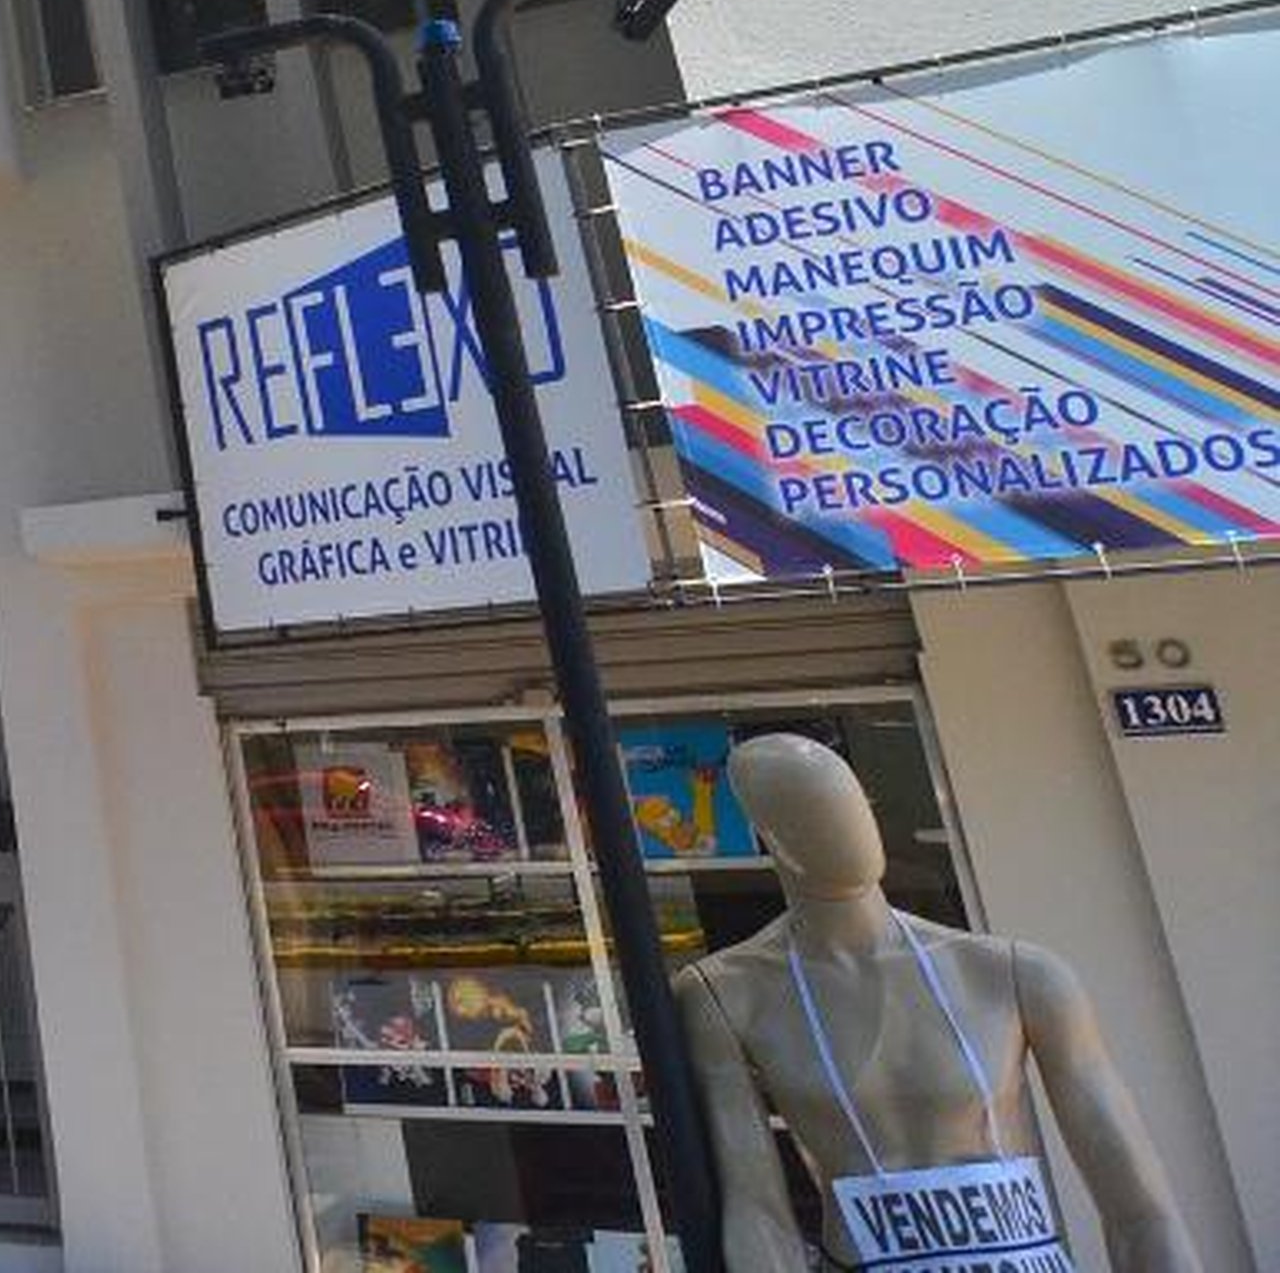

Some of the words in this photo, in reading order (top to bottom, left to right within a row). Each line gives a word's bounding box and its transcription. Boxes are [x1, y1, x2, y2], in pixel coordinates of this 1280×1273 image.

[697, 141, 901, 202] BANNER
[714, 188, 932, 252] ADESIVO
[725, 229, 1016, 303] MANEQUIM
[737, 281, 1035, 353] IMPRESSÃO
[750, 349, 957, 406] VITRINE
[764, 387, 1100, 459] DECORAÇÃO
[222, 465, 452, 538] COMUNICAÇÃO
[460, 446, 598, 502] VISAL
[778, 429, 1280, 513] PERSONALIZADOS
[257, 537, 391, 586] GRÁFICA
[397, 542, 418, 570] e
[423, 518, 522, 566] VITRI
[1123, 691, 1215, 725] 1304
[853, 1176, 1050, 1254] VENDEMOS
